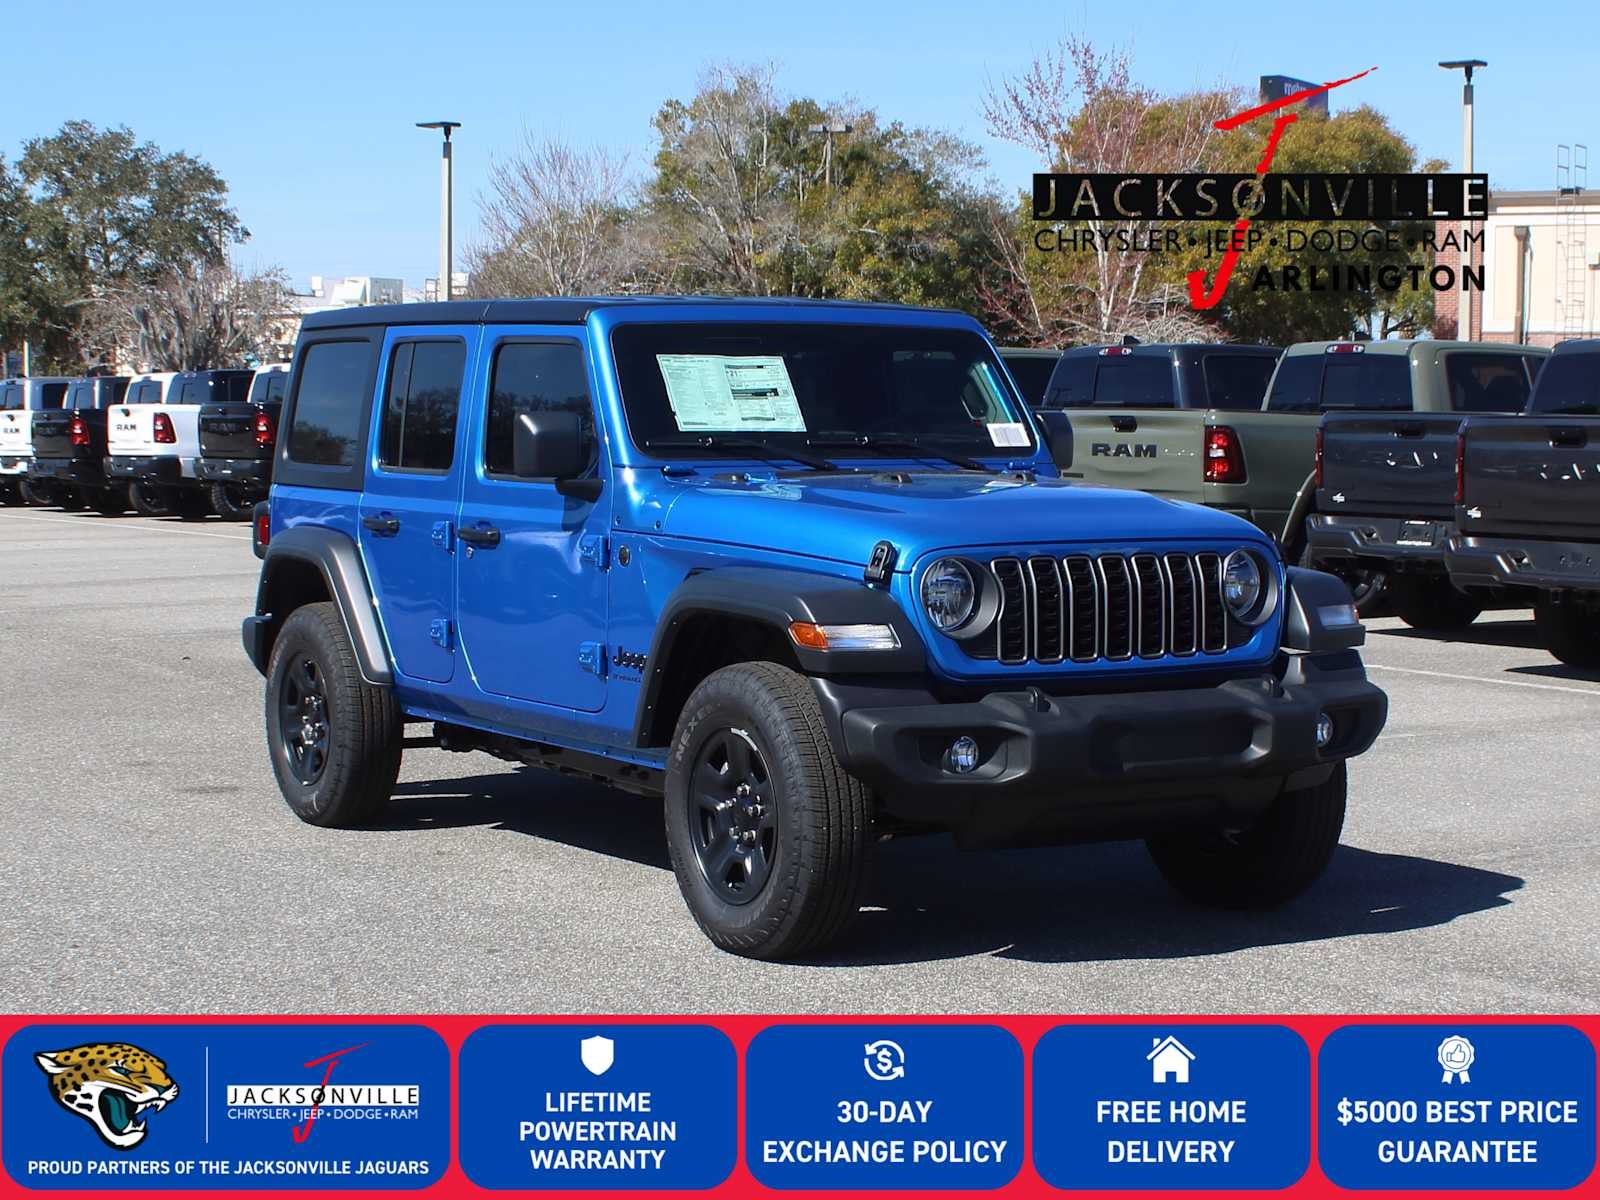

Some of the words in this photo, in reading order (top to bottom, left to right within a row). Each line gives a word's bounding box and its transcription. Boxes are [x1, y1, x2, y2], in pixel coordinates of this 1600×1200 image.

[115, 423, 137, 431] RAM
[1091, 443, 1158, 458] RAM
[613, 645, 648, 674] Jeep
